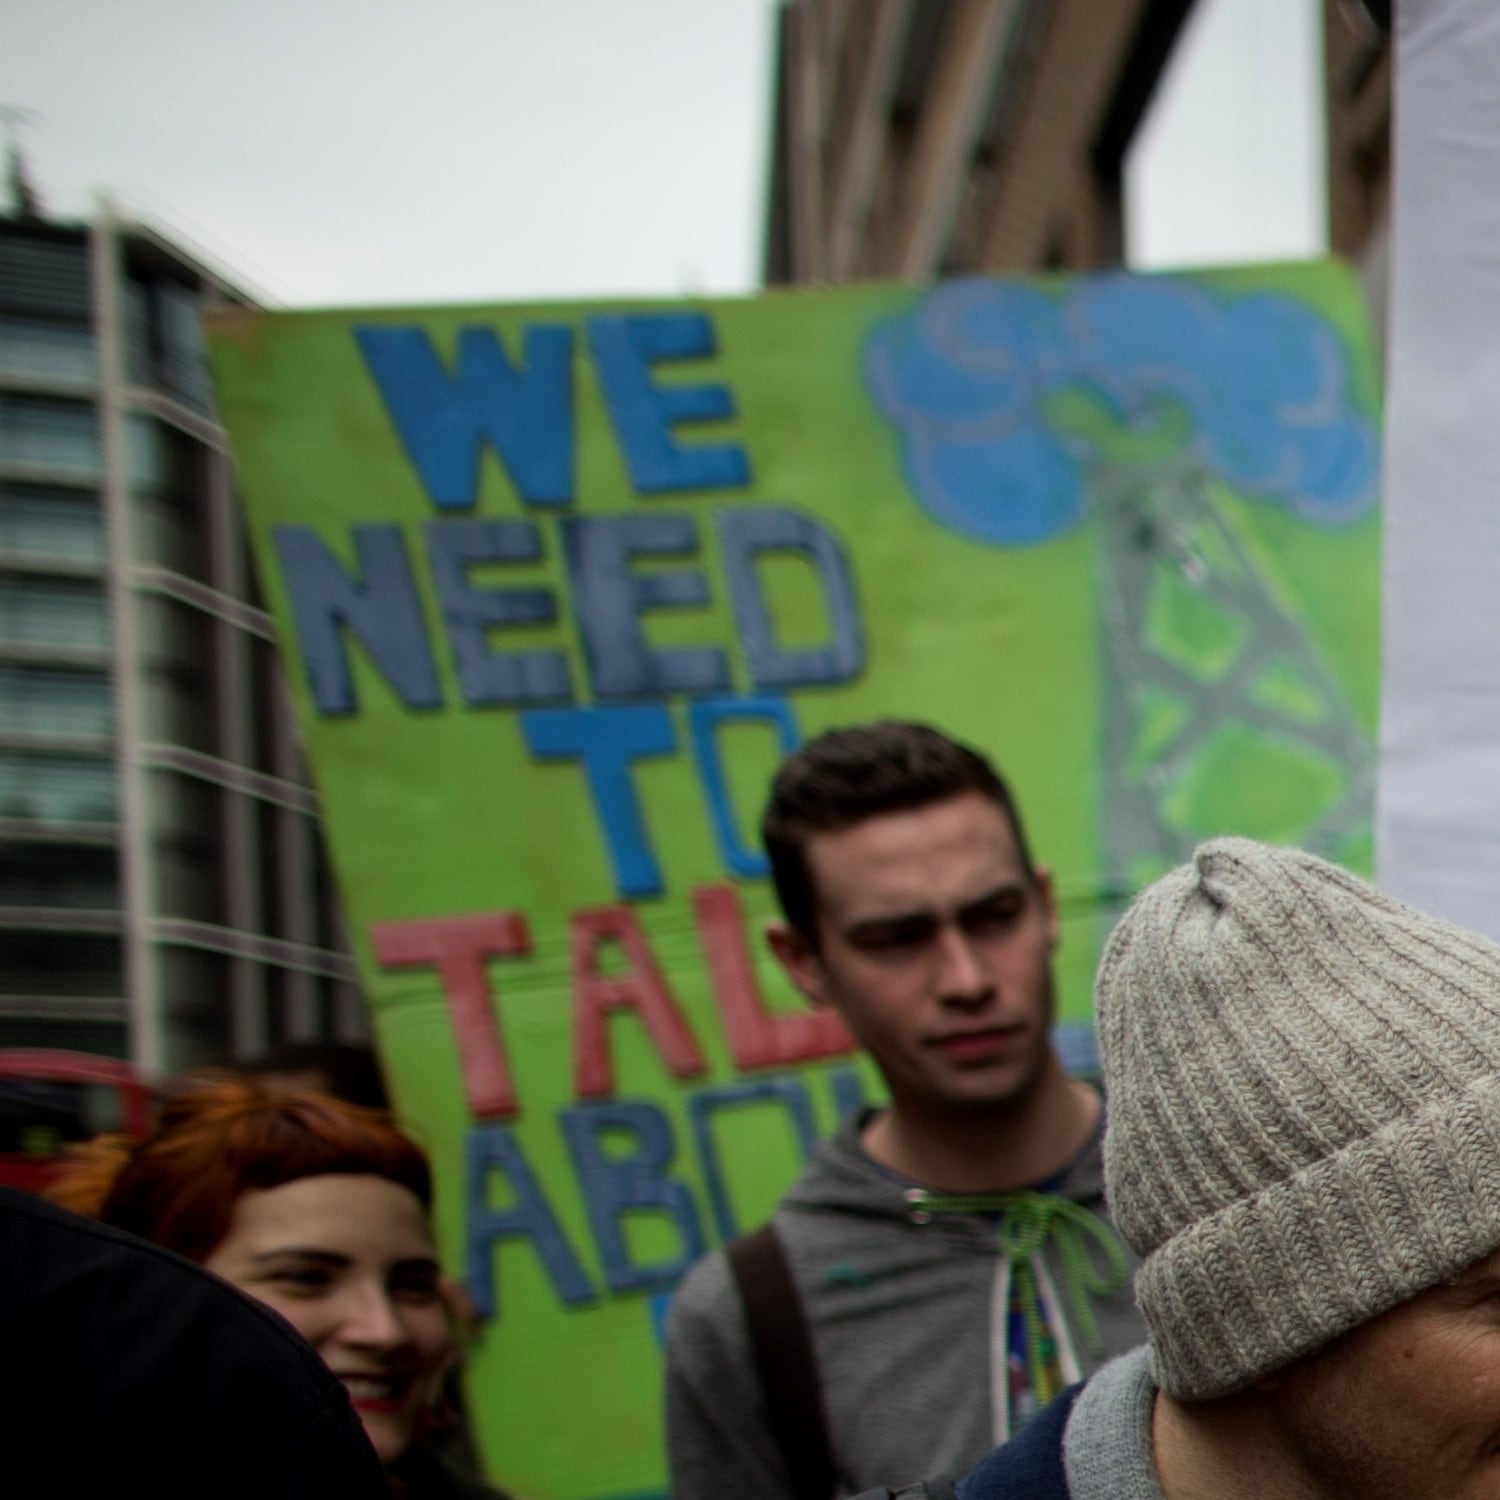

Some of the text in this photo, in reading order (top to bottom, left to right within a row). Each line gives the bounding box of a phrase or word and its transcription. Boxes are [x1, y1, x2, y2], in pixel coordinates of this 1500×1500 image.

[351, 310, 753, 512] WE
[269, 503, 869, 721] NEED
[516, 688, 800, 899] TO
[370, 882, 858, 1120] TAL
[462, 1062, 864, 1320] ABO
